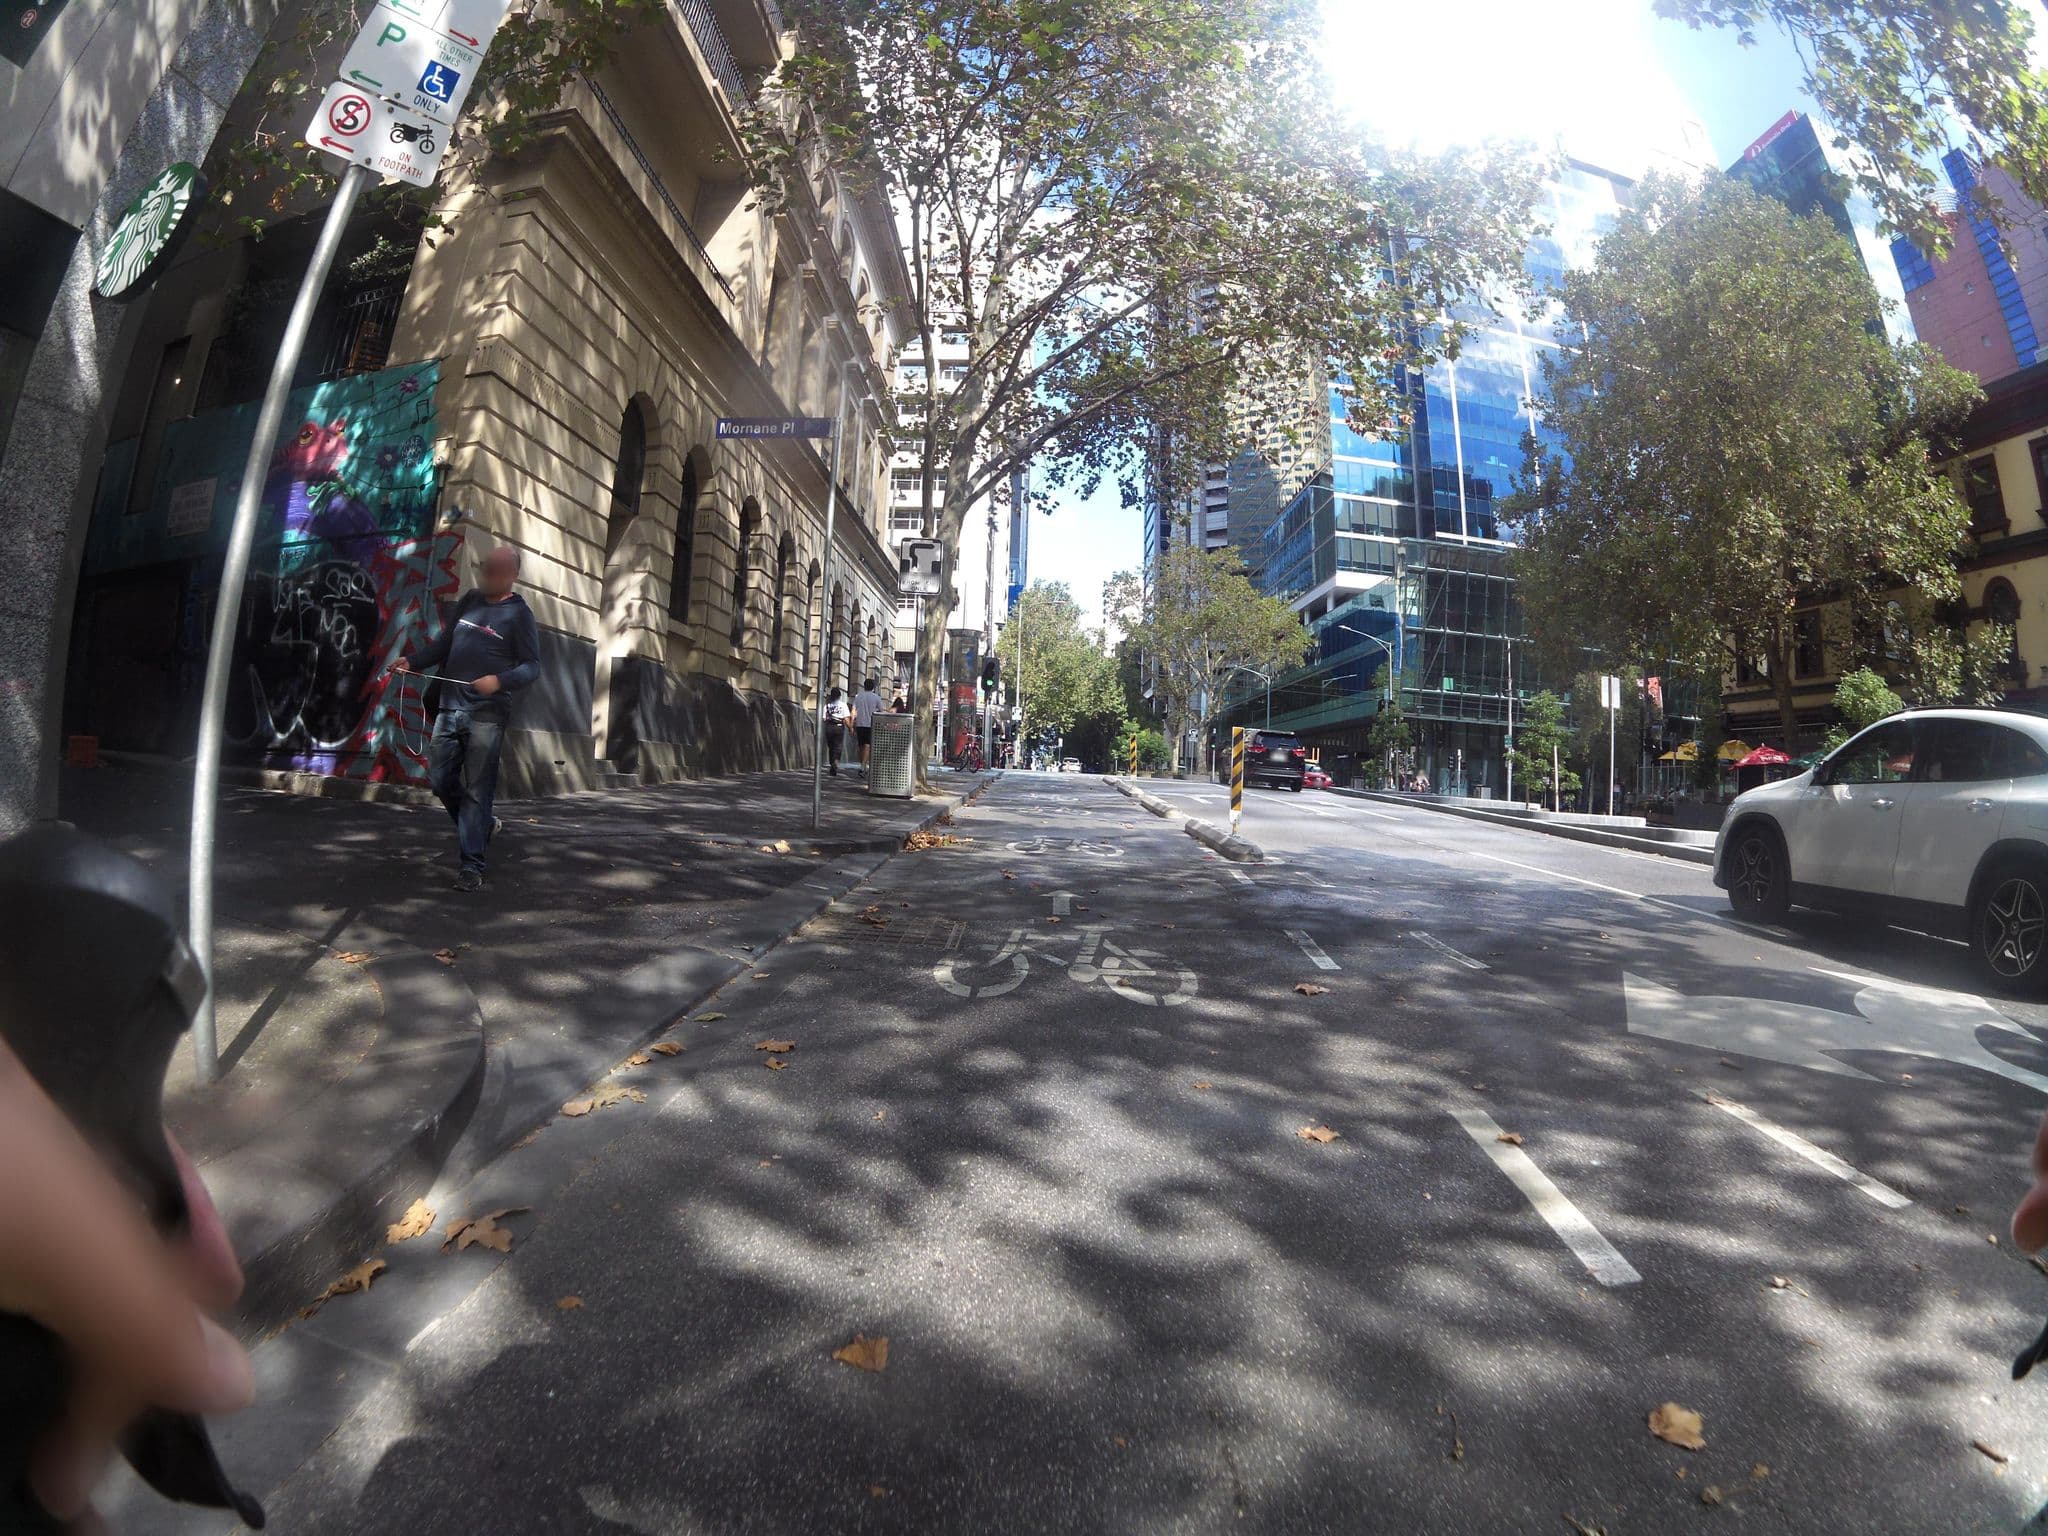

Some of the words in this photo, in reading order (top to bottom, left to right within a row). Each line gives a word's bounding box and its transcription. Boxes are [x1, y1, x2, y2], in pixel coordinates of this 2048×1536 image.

[376, 21, 406, 48] P
[440, 51, 461, 67] TIMES
[449, 46, 473, 64] OTHER
[413, 94, 441, 115] ONLY
[399, 151, 411, 164] ON
[379, 157, 423, 179] FOOTPATH
[719, 422, 777, 434] Mornane
[782, 422, 795, 434] Pl
